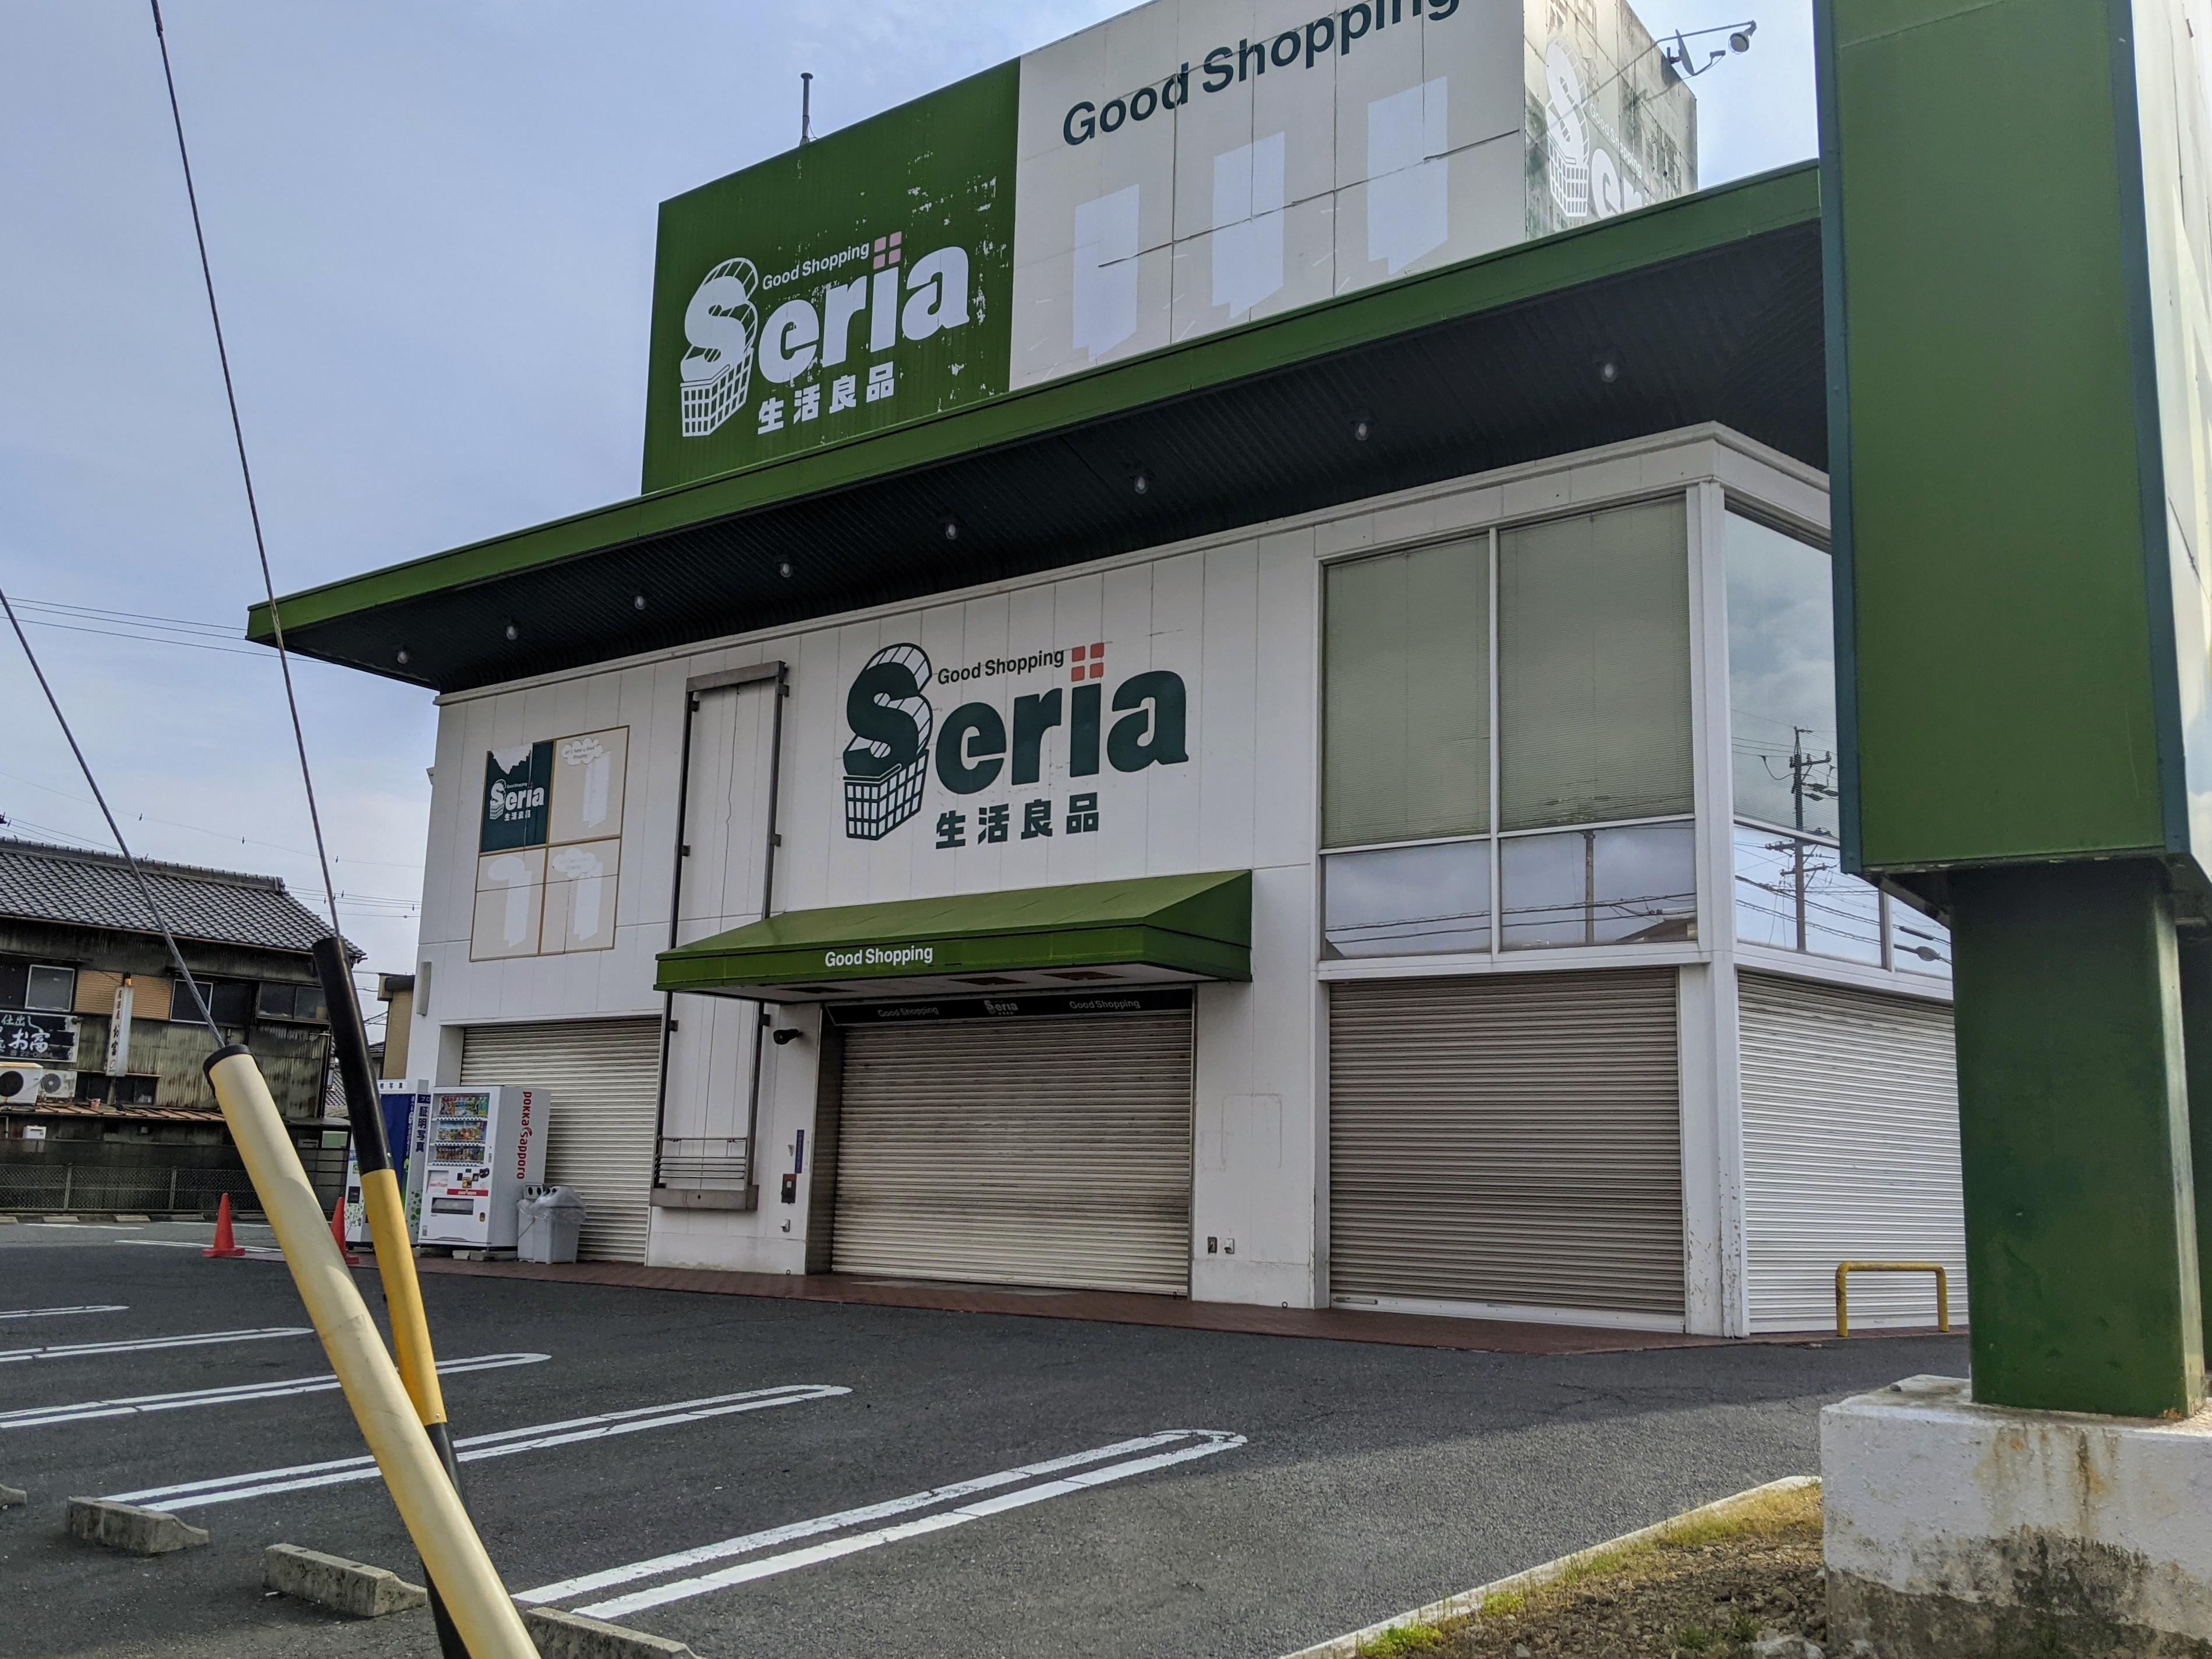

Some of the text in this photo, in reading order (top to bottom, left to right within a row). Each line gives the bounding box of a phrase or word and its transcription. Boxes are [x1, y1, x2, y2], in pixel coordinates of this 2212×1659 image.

[1063, 62, 1188, 146] Good
[1590, 102, 1609, 136] Good
[763, 243, 870, 289] Good Shopping
[680, 232, 969, 387] Seria
[758, 362, 895, 434] 生活良品
[937, 649, 1065, 685] Good Shopping
[843, 643, 1189, 798] Seria
[490, 779, 544, 811] Seria
[935, 792, 1099, 850] 生活良品
[825, 945, 933, 967] Good Shopping
[900, 1006, 939, 1016] Shopping
[1070, 999, 1141, 1010] Good Shopping
[416, 1106, 429, 1152] 証明写真
